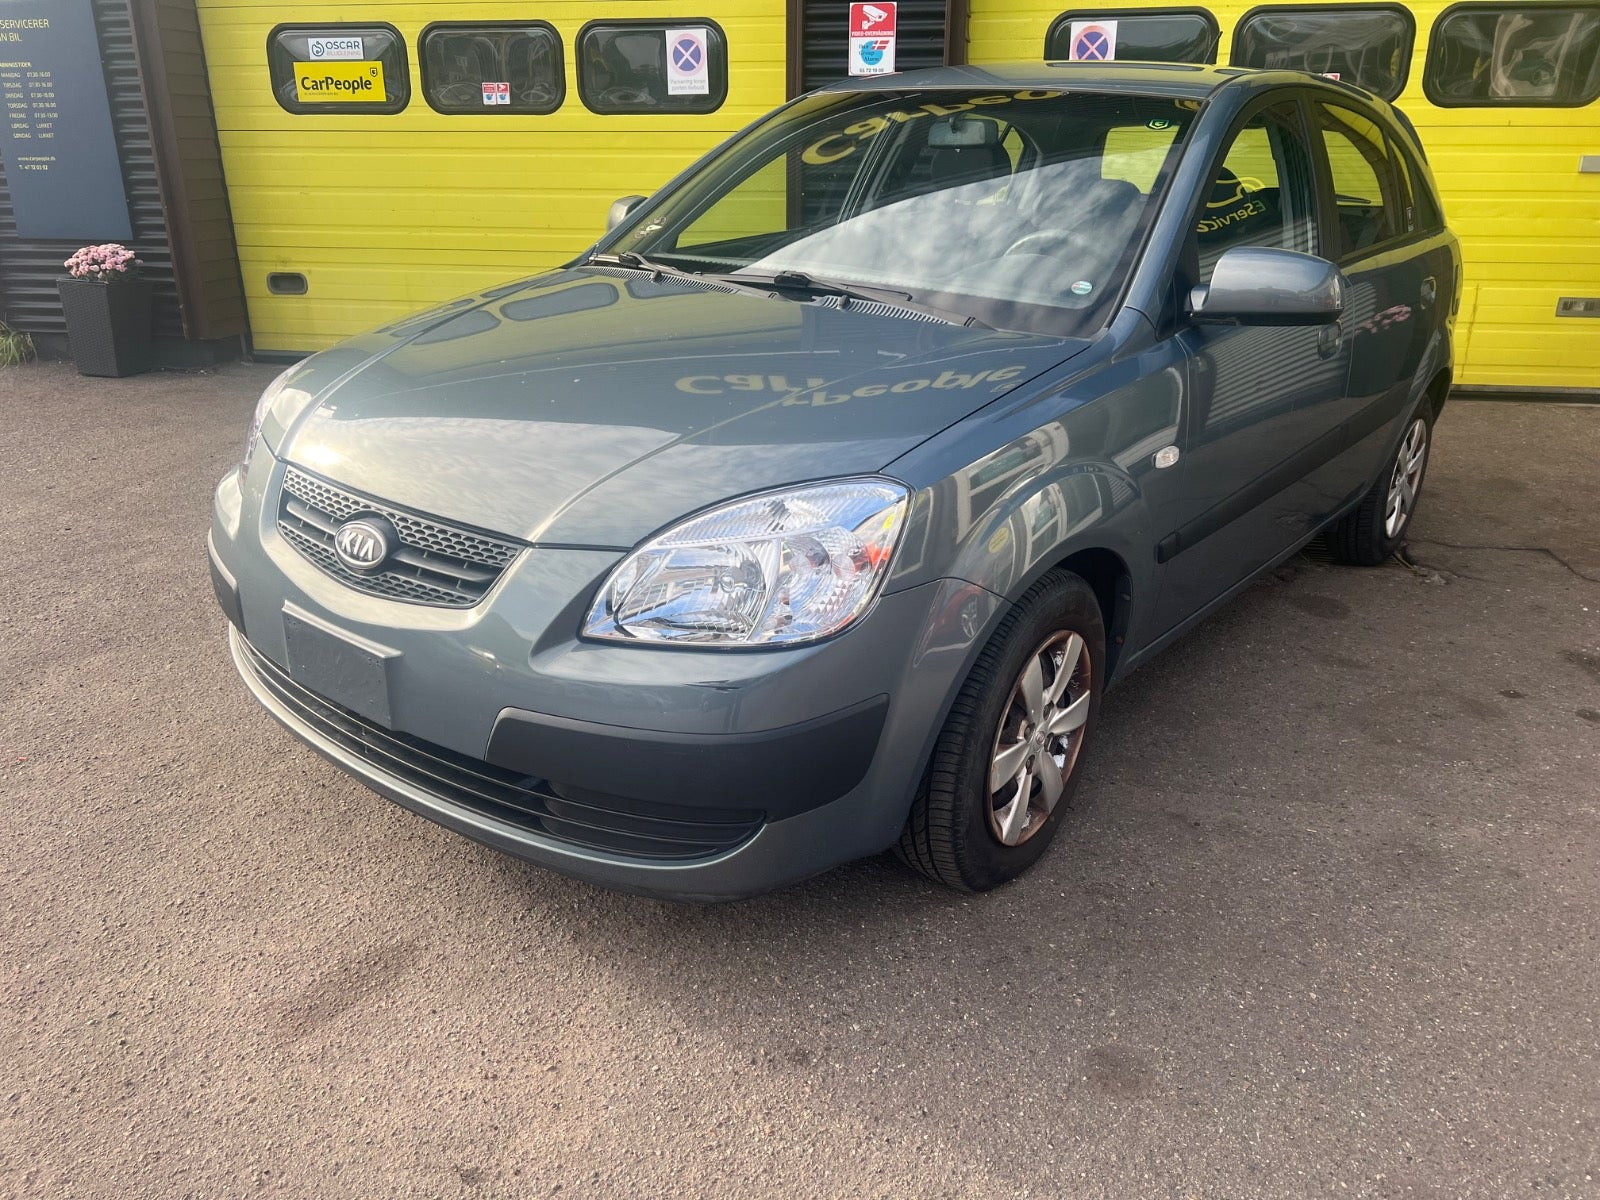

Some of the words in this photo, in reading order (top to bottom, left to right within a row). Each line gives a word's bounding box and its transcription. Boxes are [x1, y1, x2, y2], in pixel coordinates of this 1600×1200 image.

[0, 18, 50, 29] SERVICERER
[9, 32, 23, 42] BIL
[325, 41, 360, 50] OSCAR
[301, 76, 372, 94] CarPeople
[341, 530, 375, 561] KIA
